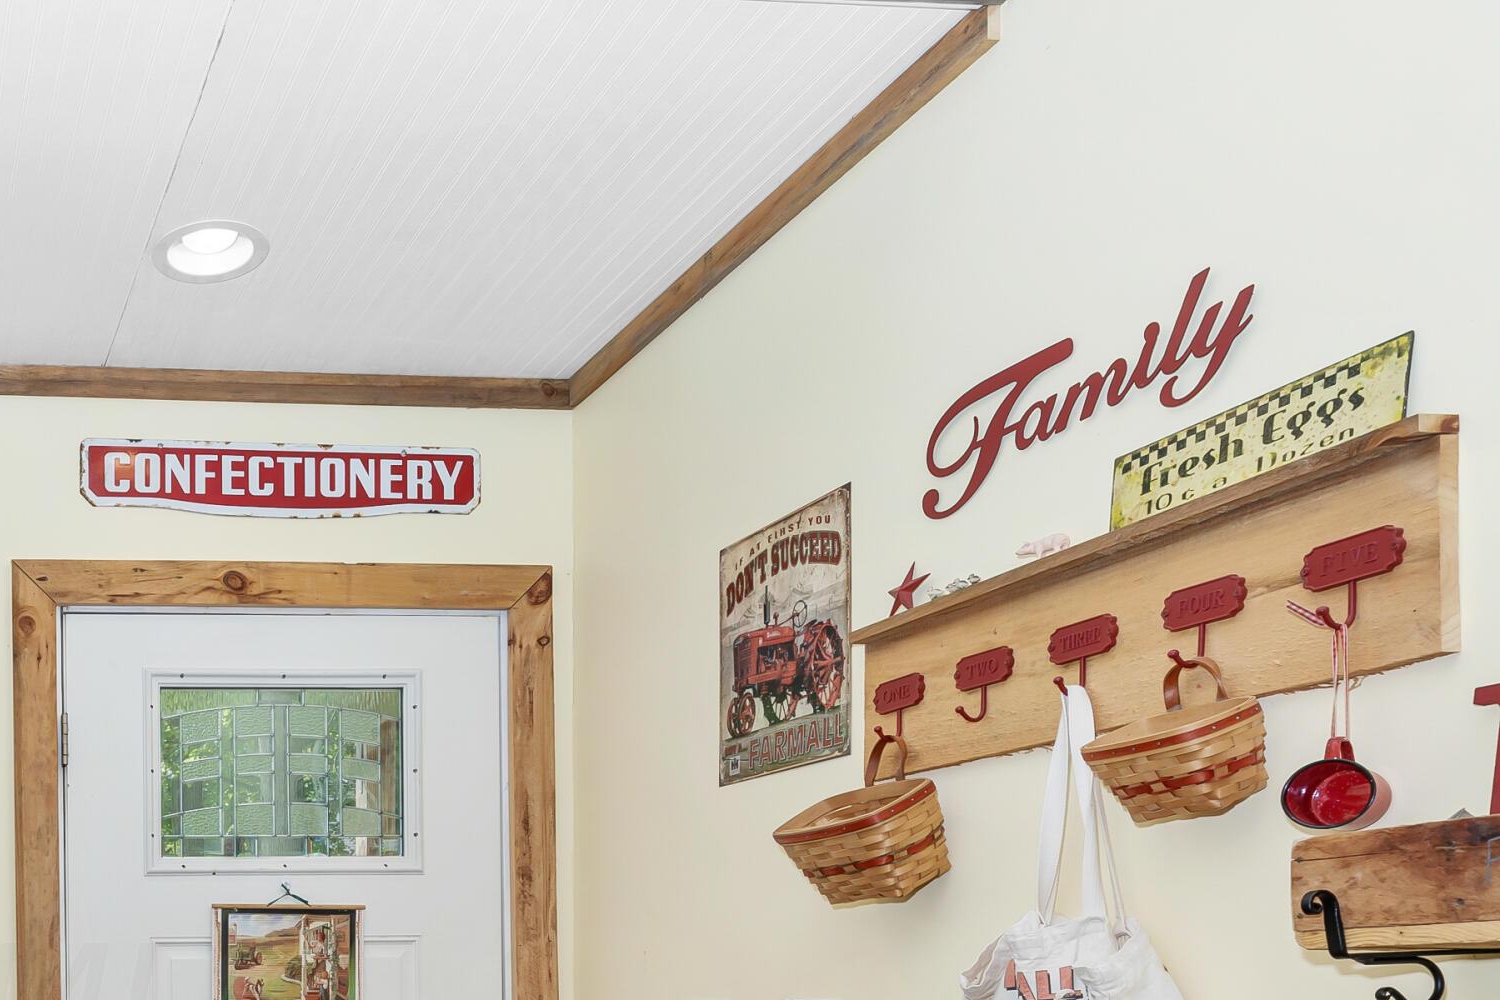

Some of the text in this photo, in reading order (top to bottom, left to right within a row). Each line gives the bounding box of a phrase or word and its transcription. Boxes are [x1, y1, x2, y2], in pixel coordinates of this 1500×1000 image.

[922, 266, 1255, 520] Family
[1139, 386, 1365, 496] Fresh Eggs
[104, 451, 464, 500] CONFECTIONERY
[749, 540, 762, 558] AT
[766, 520, 801, 543] FIRST
[808, 514, 831, 526] YOU
[725, 530, 842, 618] DON'T SUCCEED
[1320, 541, 1379, 577] FIVE
[1179, 588, 1225, 620] FOUR
[1059, 627, 1101, 653] THREE
[965, 658, 998, 681] TWO
[882, 683, 911, 705] ONE
[748, 711, 844, 770] FARMALL
